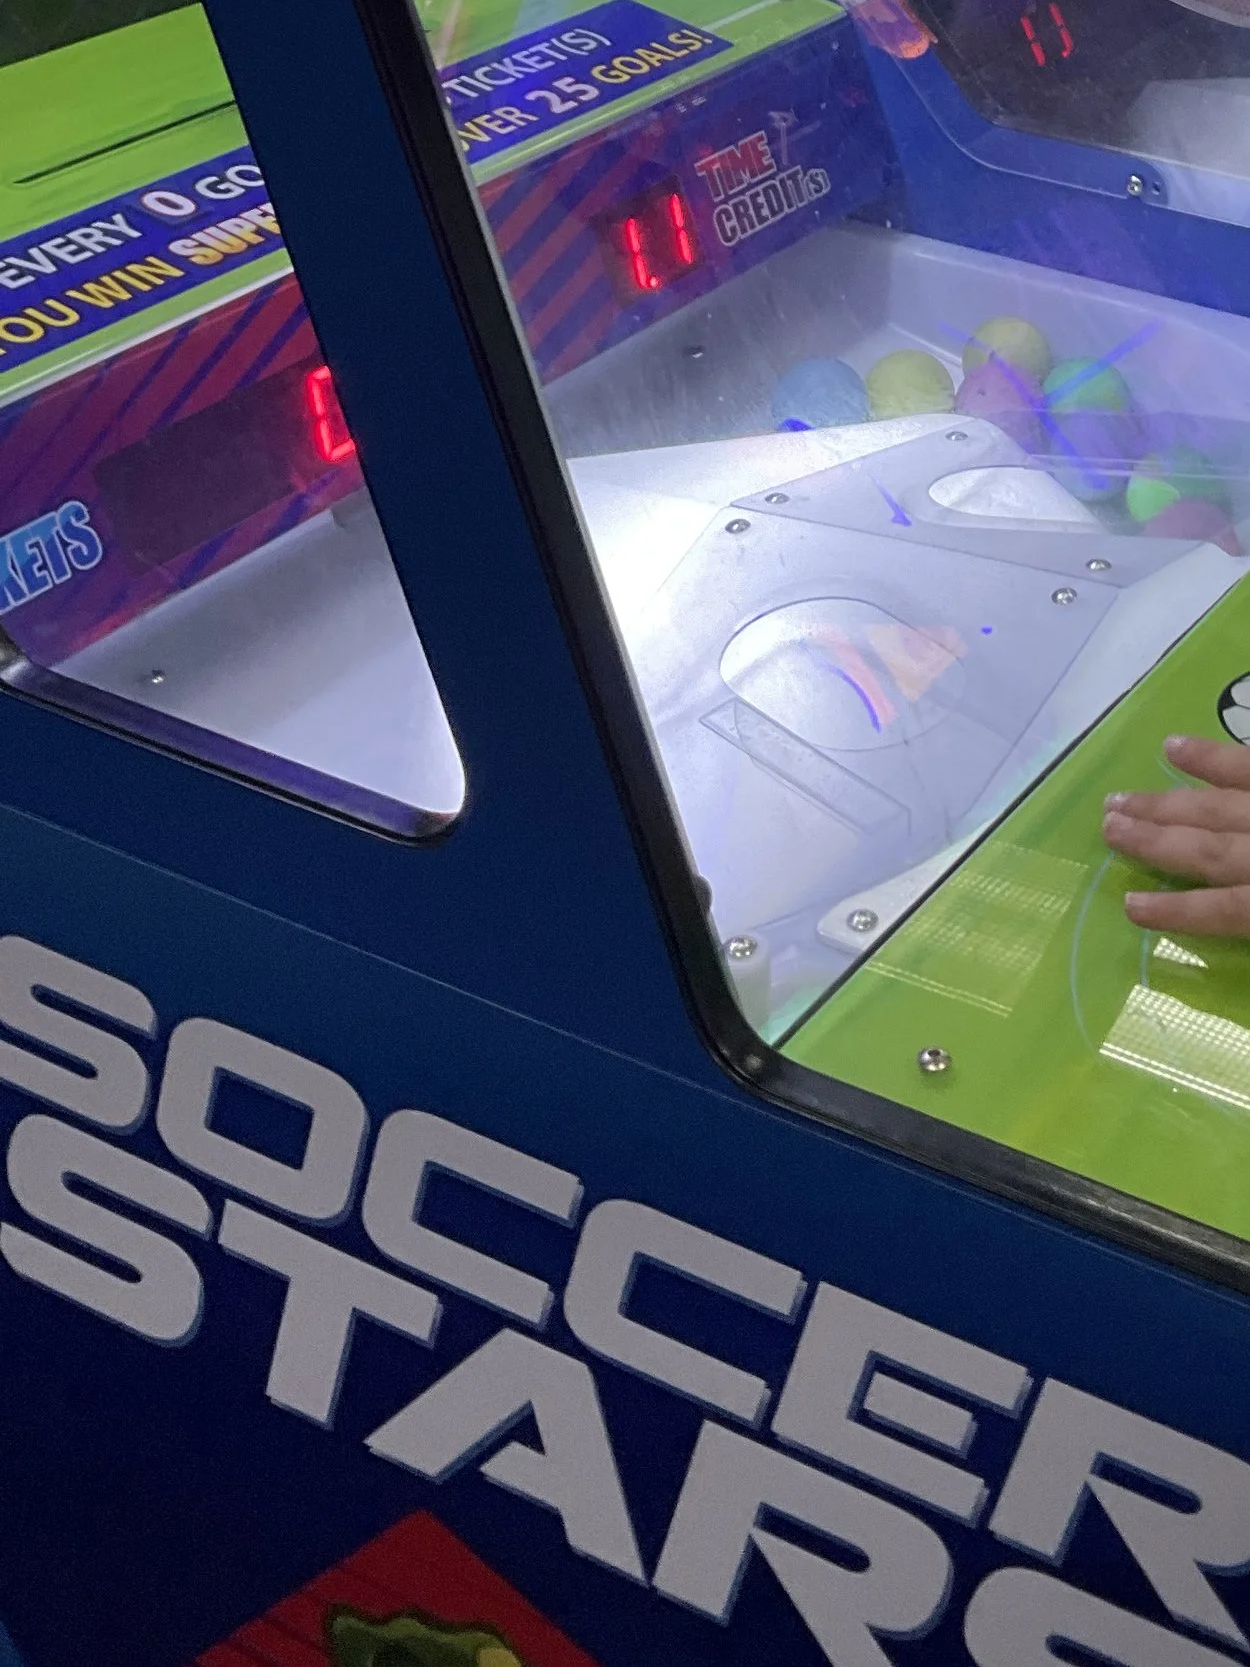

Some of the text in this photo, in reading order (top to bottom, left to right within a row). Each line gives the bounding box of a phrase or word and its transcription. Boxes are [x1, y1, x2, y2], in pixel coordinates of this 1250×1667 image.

[0, 299, 80, 356] OU
[65, 256, 185, 309] WIN
[524, 76, 600, 114] 25
[591, 29, 714, 84] GOALS!
[195, 164, 264, 200] GO
[693, 130, 778, 203] TIME
[712, 165, 832, 247] CREDIT(S)
